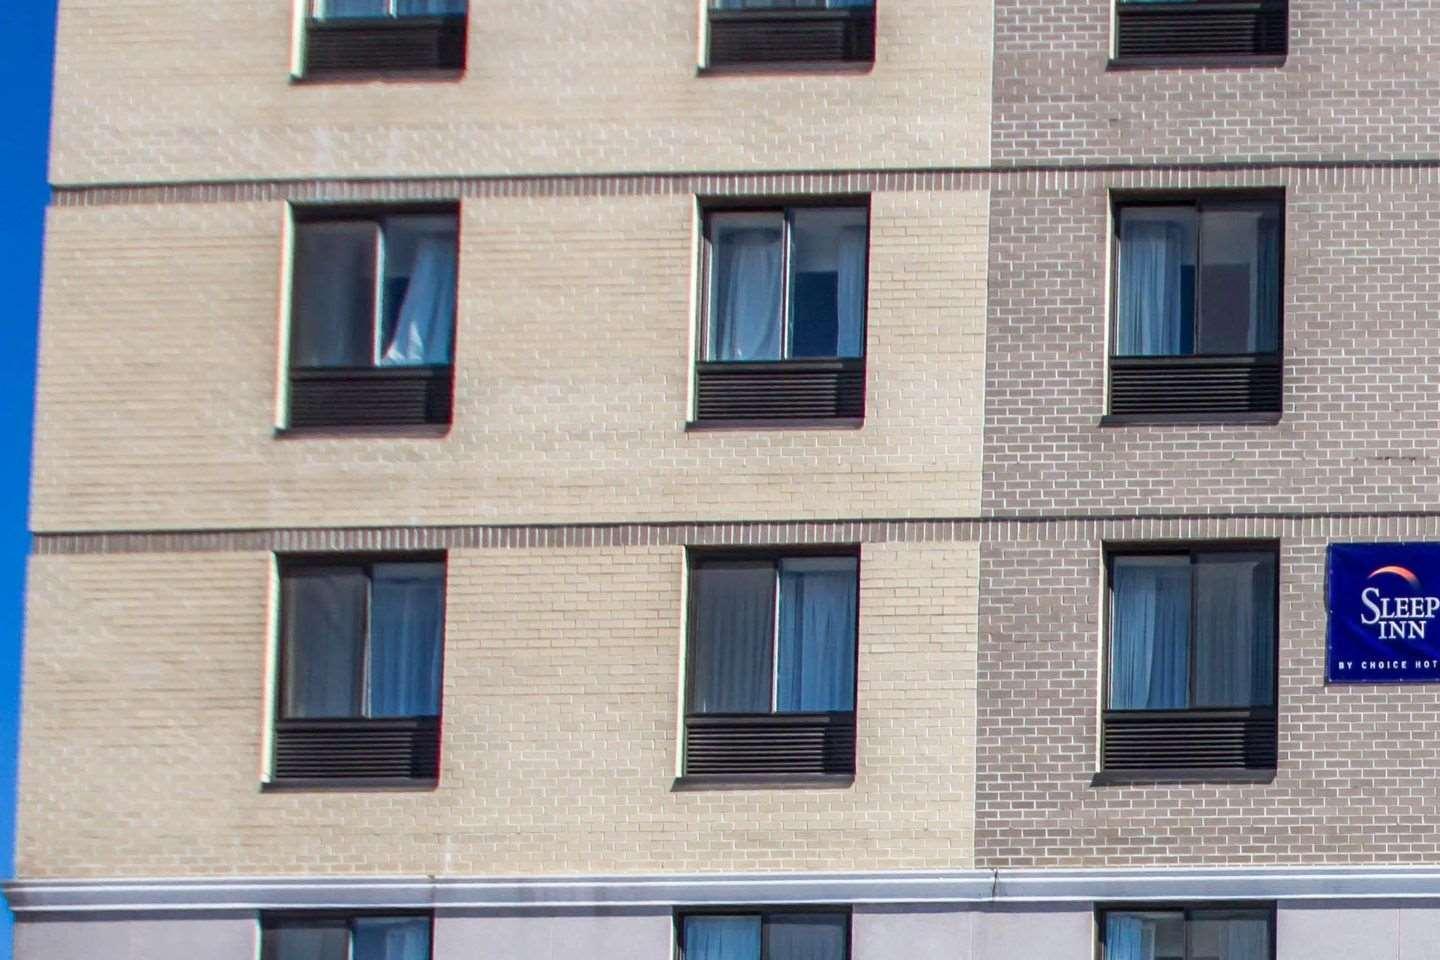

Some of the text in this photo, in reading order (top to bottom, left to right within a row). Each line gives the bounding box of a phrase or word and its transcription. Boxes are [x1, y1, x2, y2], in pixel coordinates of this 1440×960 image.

[1360, 587, 1440, 624] SLEEP
[1378, 620, 1427, 639] INN
[1338, 661, 1353, 670] BY
[1361, 660, 1408, 669] CHOICE
